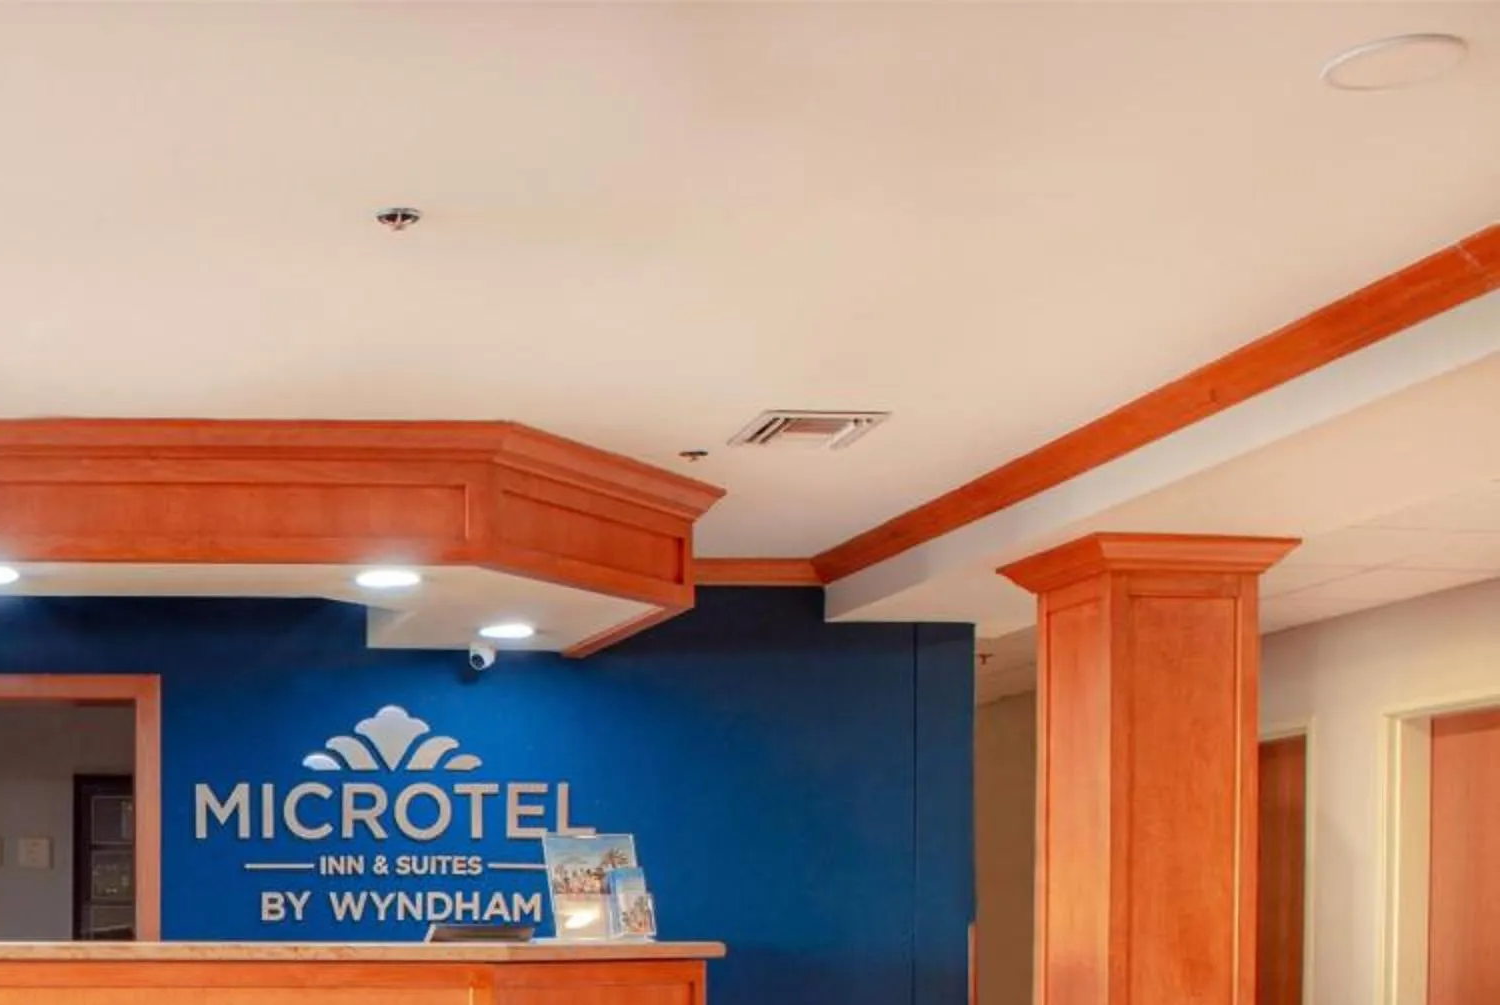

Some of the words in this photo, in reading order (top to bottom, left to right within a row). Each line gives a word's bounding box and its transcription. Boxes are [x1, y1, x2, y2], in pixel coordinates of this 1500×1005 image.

[194, 782, 597, 841] MICROTEL
[319, 855, 365, 876] INN
[372, 855, 389, 876] &
[394, 855, 484, 876] SUITES
[260, 891, 312, 922] BY
[328, 891, 543, 923] WYNDHAM
